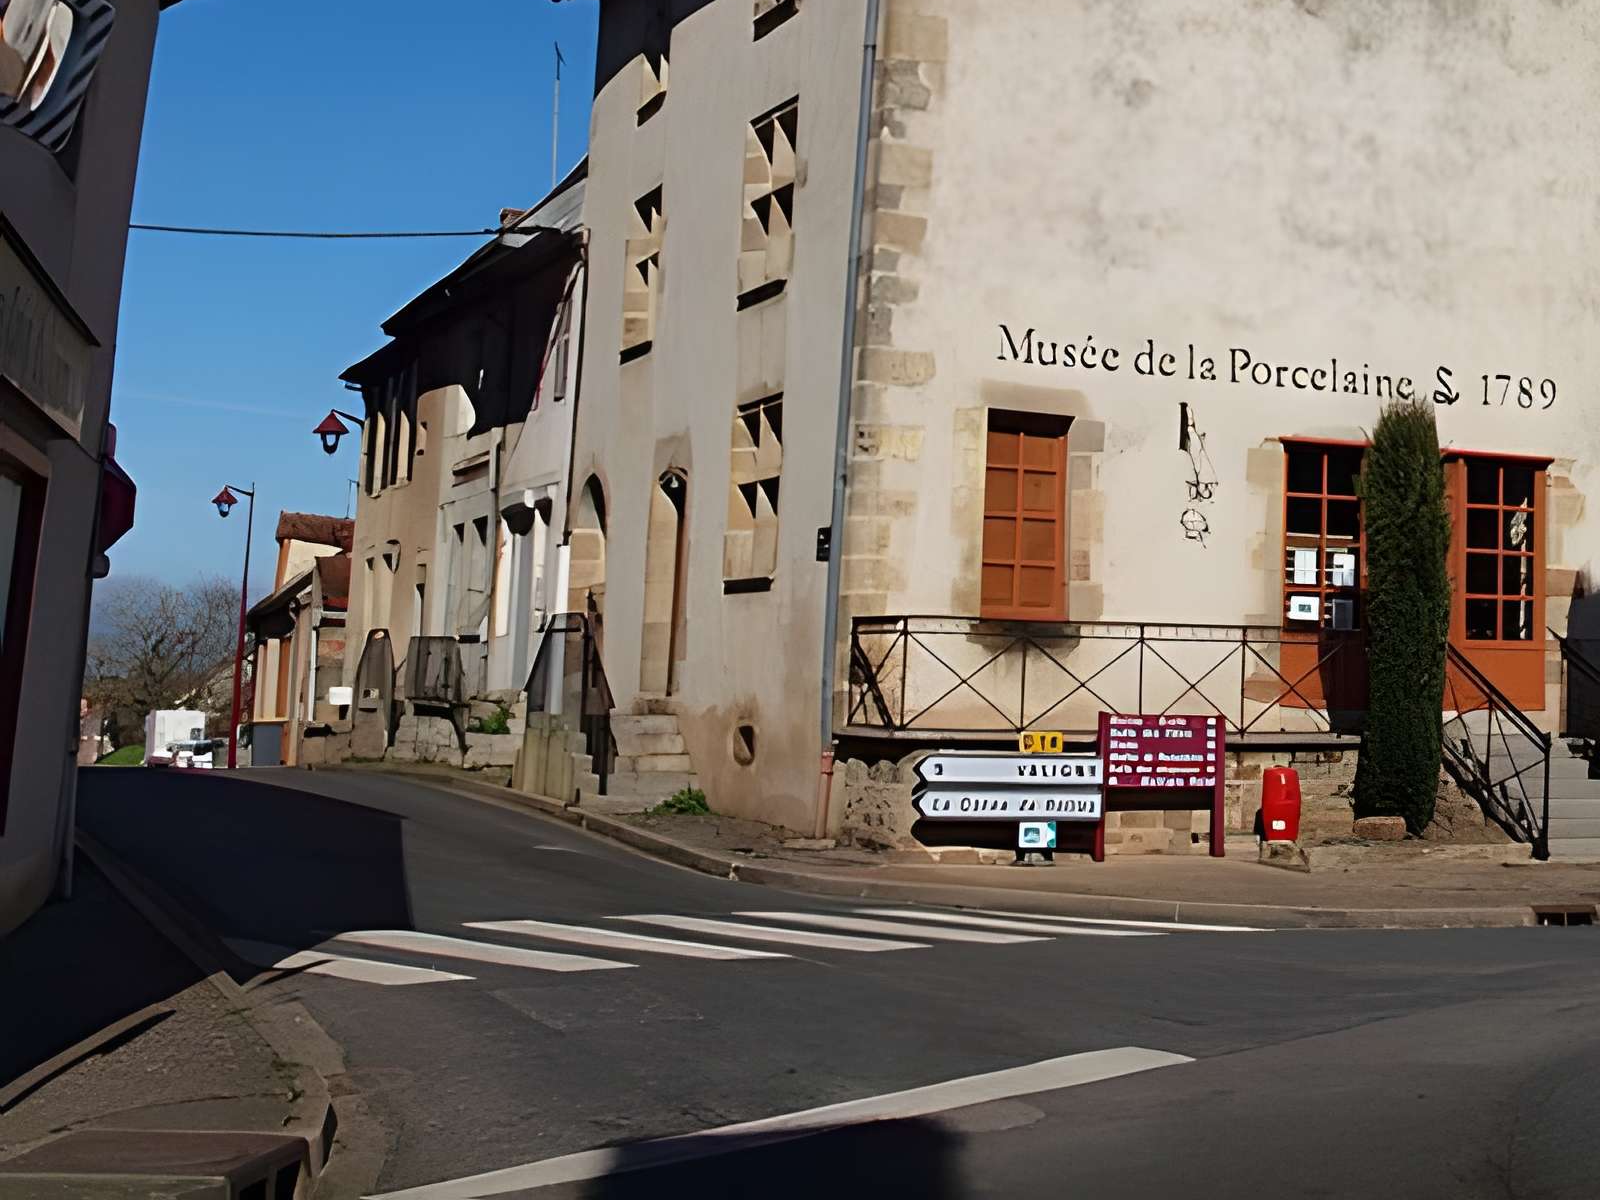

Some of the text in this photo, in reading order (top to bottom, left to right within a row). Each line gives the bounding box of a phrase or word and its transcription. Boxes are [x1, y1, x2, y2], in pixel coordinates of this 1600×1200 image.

[997, 324, 1120, 372] Musée
[1134, 339, 1177, 376] de
[1187, 344, 1217, 381] la
[1229, 348, 1414, 401] Porcelaine
[1481, 373, 1557, 410] 1789
